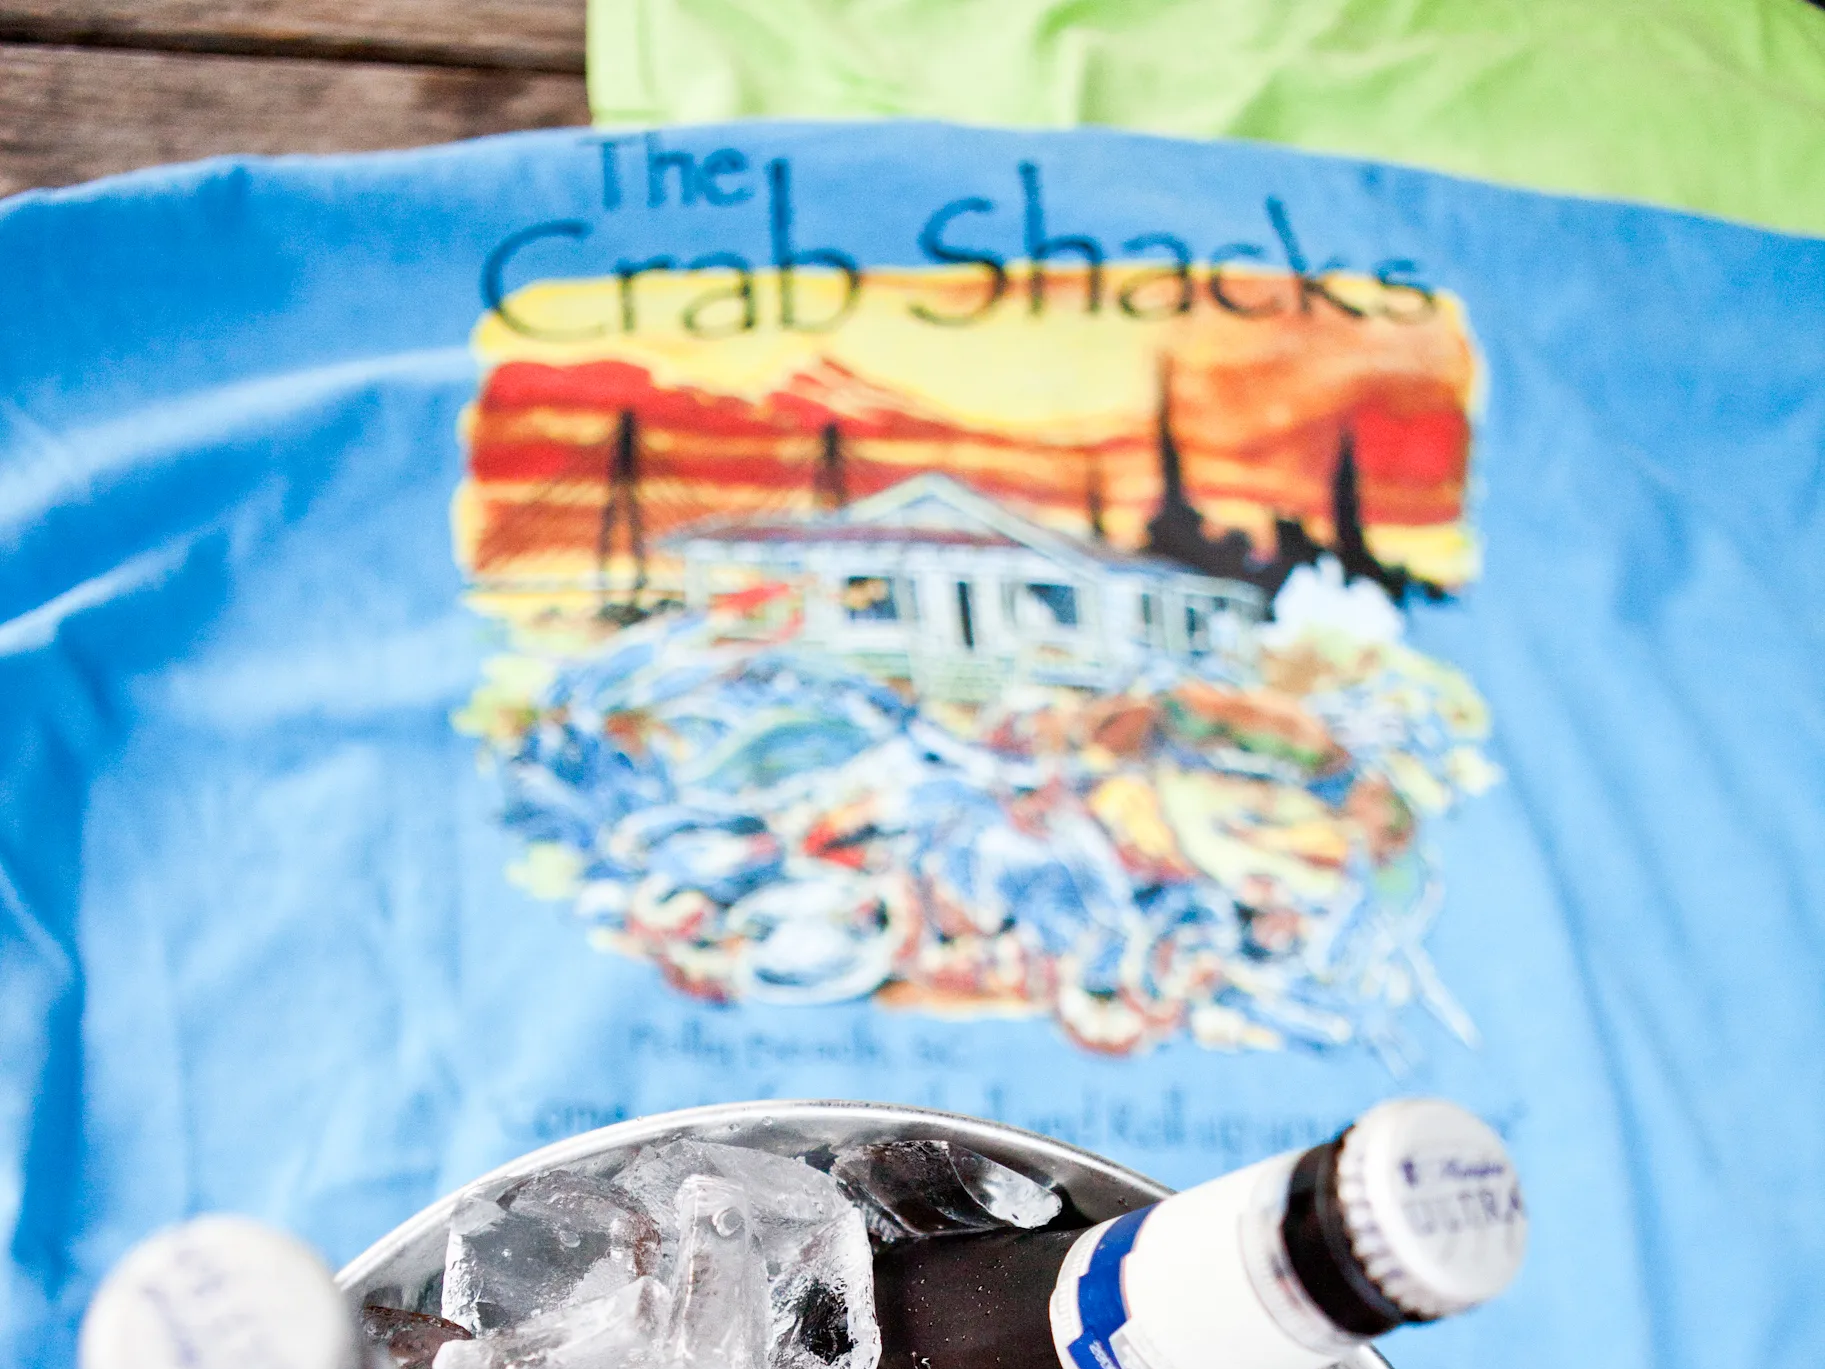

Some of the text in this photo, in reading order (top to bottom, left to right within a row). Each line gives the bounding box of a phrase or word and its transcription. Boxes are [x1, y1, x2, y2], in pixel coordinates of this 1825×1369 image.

[577, 130, 754, 210] The
[480, 157, 1438, 343] Crab Shacks
